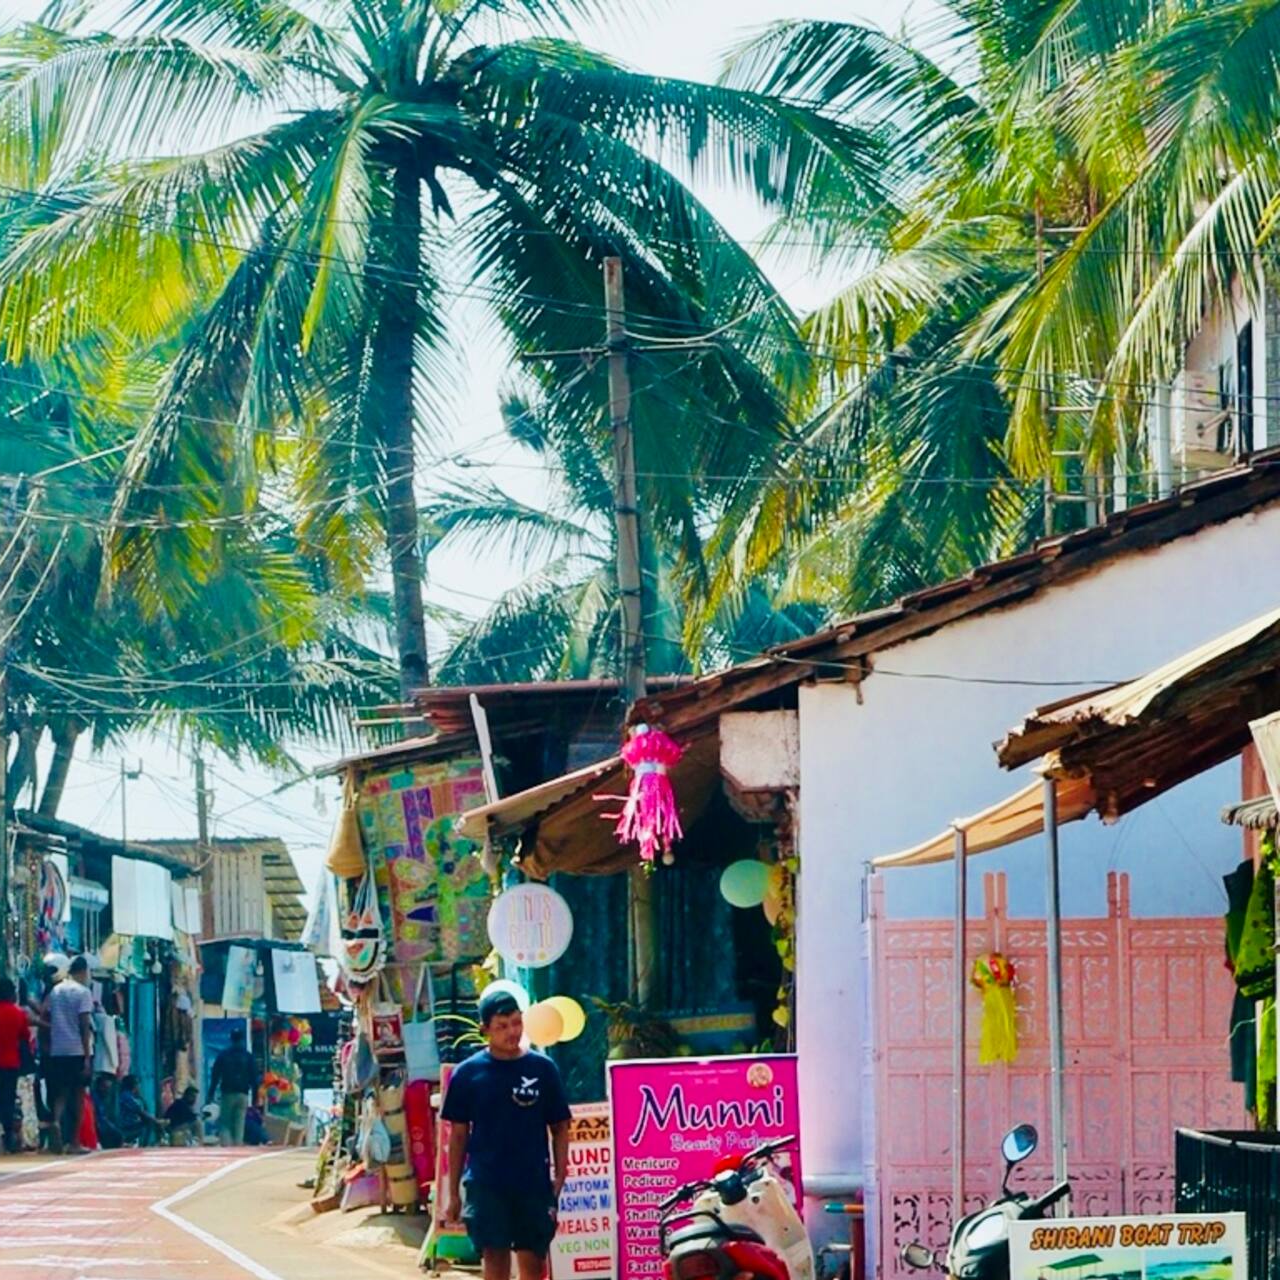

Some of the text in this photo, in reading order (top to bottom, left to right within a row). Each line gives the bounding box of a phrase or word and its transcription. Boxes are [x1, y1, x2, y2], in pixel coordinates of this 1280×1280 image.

[629, 1084, 784, 1146] Munni
[623, 1174, 677, 1188] Pedicure
[1030, 1222, 1226, 1250] SHIBANI BOAT TRIP
